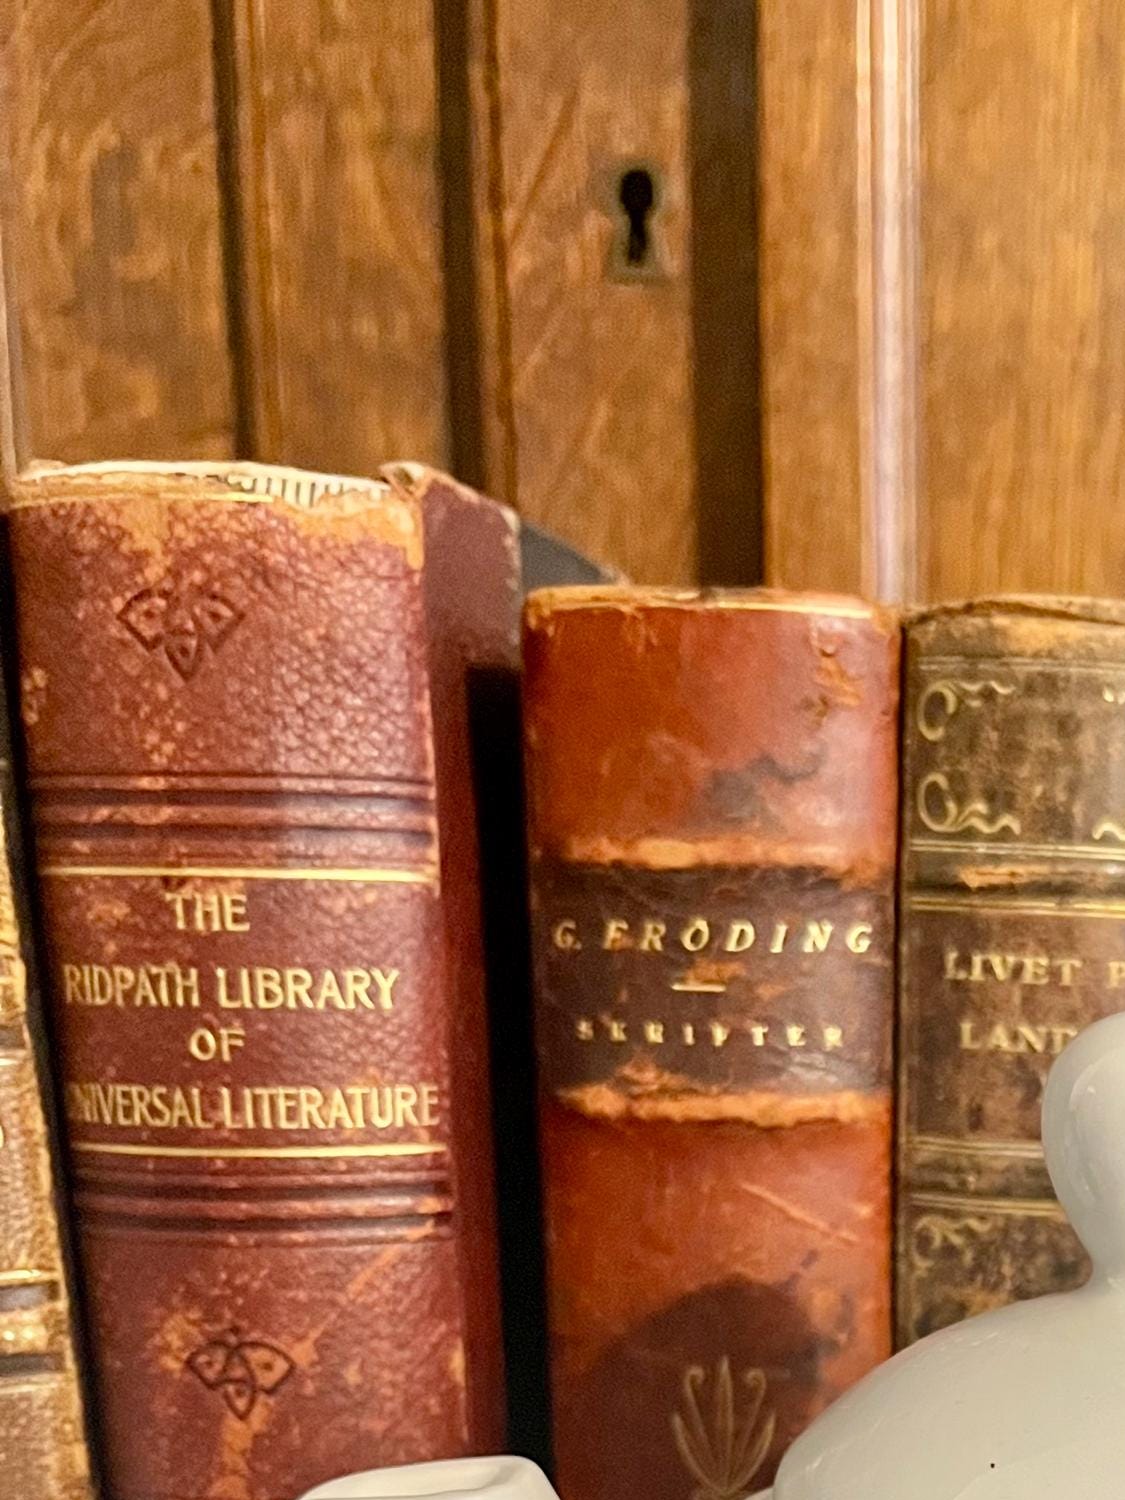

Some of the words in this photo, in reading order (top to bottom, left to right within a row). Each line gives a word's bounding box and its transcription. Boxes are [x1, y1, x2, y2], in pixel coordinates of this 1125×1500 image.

[165, 891, 250, 933] THE
[63, 963, 200, 1007] RIDPATH
[216, 967, 400, 1010] LIBRARY
[943, 949, 1082, 987] LIVET
[188, 1027, 246, 1061] OF
[68, 1083, 214, 1129] NIVERSAL
[221, 1084, 441, 1130] LITERATURE
